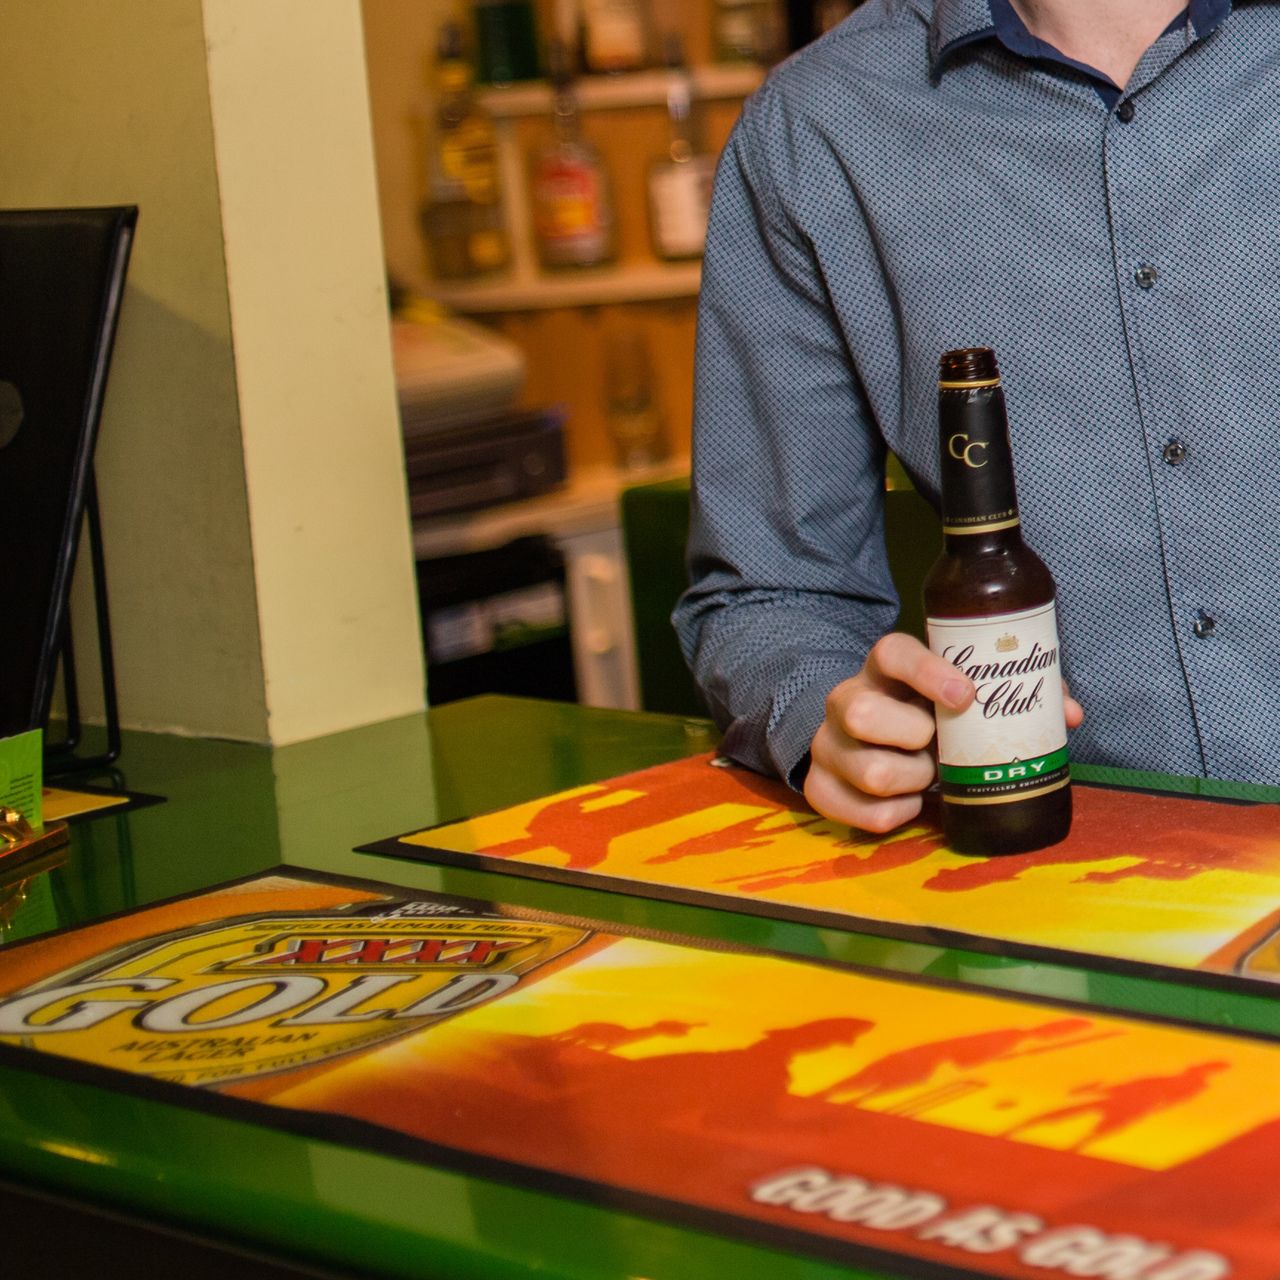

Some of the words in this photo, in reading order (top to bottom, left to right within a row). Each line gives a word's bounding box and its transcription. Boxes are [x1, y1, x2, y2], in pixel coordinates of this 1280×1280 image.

[948, 433, 990, 468] CC
[942, 642, 1057, 681] Canadian
[975, 676, 1044, 719] Club
[983, 761, 1046, 780] DRY
[258, 938, 530, 965] XXXX
[0, 973, 521, 1035] GOLD
[109, 1031, 320, 1053] AUSTRALIAN
[750, 1166, 947, 1230] GOOD
[920, 1205, 1044, 1253] AS
